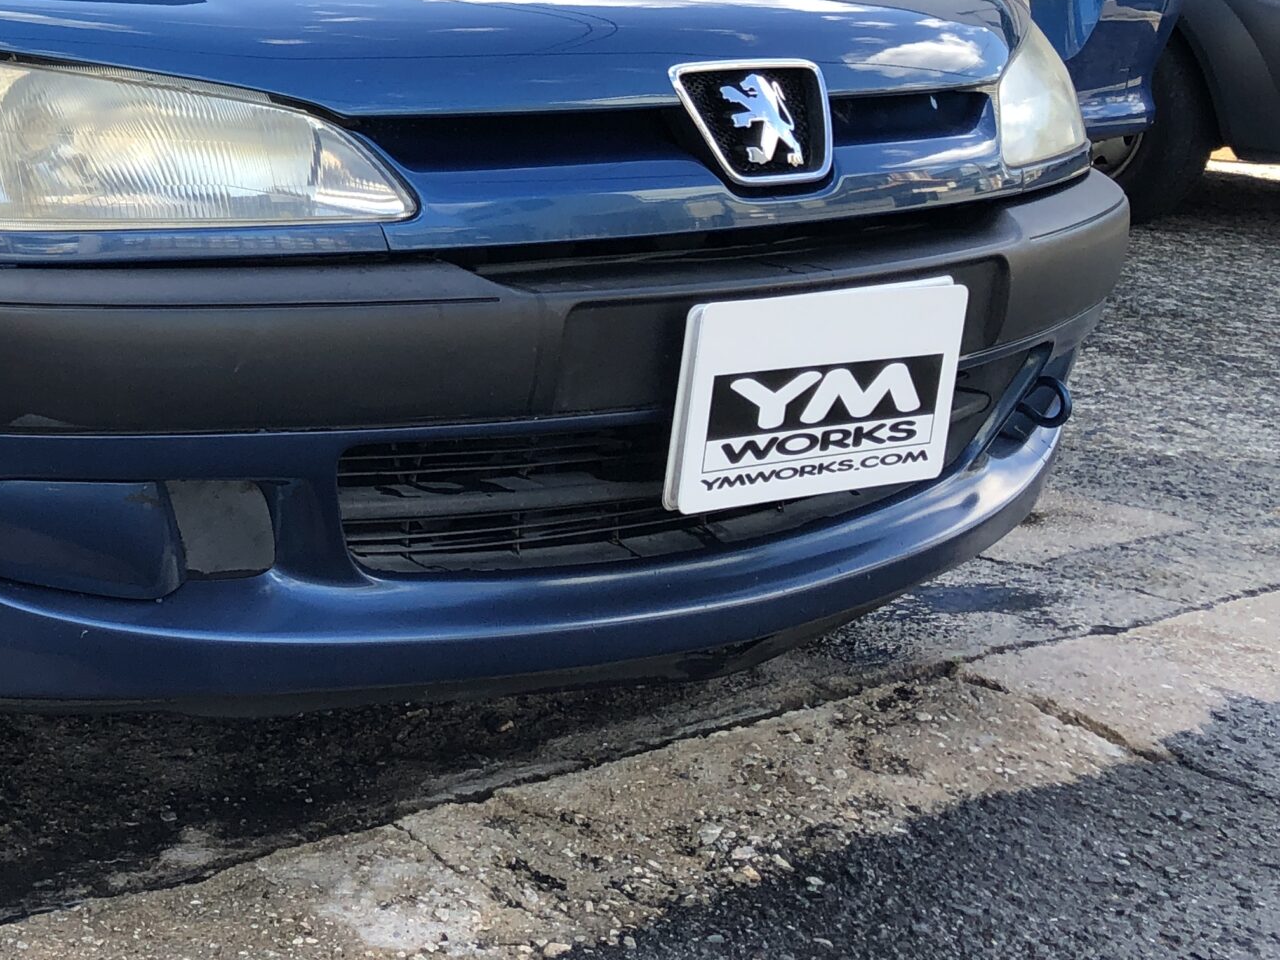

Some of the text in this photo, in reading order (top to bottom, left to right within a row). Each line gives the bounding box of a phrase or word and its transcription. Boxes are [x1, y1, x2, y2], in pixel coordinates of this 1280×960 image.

[730, 362, 921, 430] YM
[720, 420, 918, 465] WORKS
[700, 448, 929, 492] YMWORKS.COM
